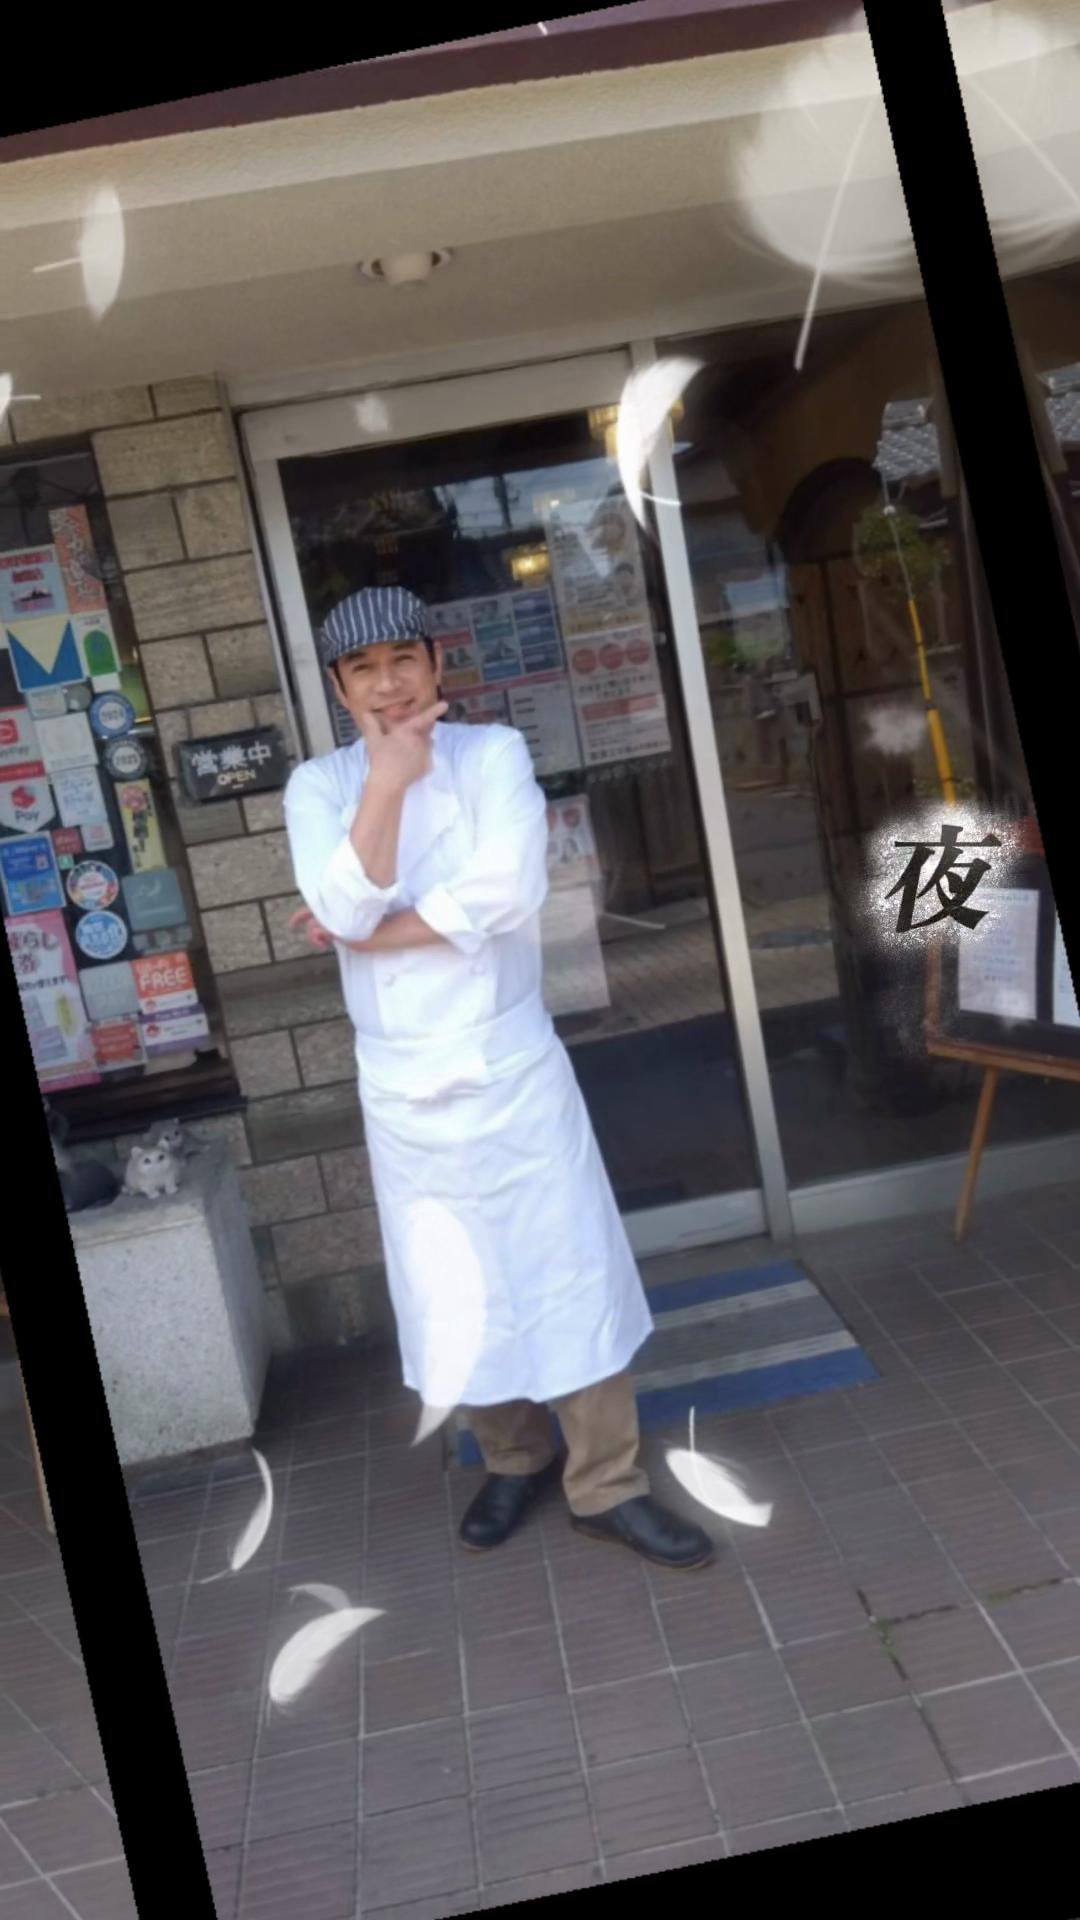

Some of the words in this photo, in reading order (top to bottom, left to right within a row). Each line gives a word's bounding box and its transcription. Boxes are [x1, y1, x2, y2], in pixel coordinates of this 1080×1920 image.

[191, 740, 272, 777] 営業中
[217, 768, 257, 786] OPEN
[139, 966, 189, 991] FREE
